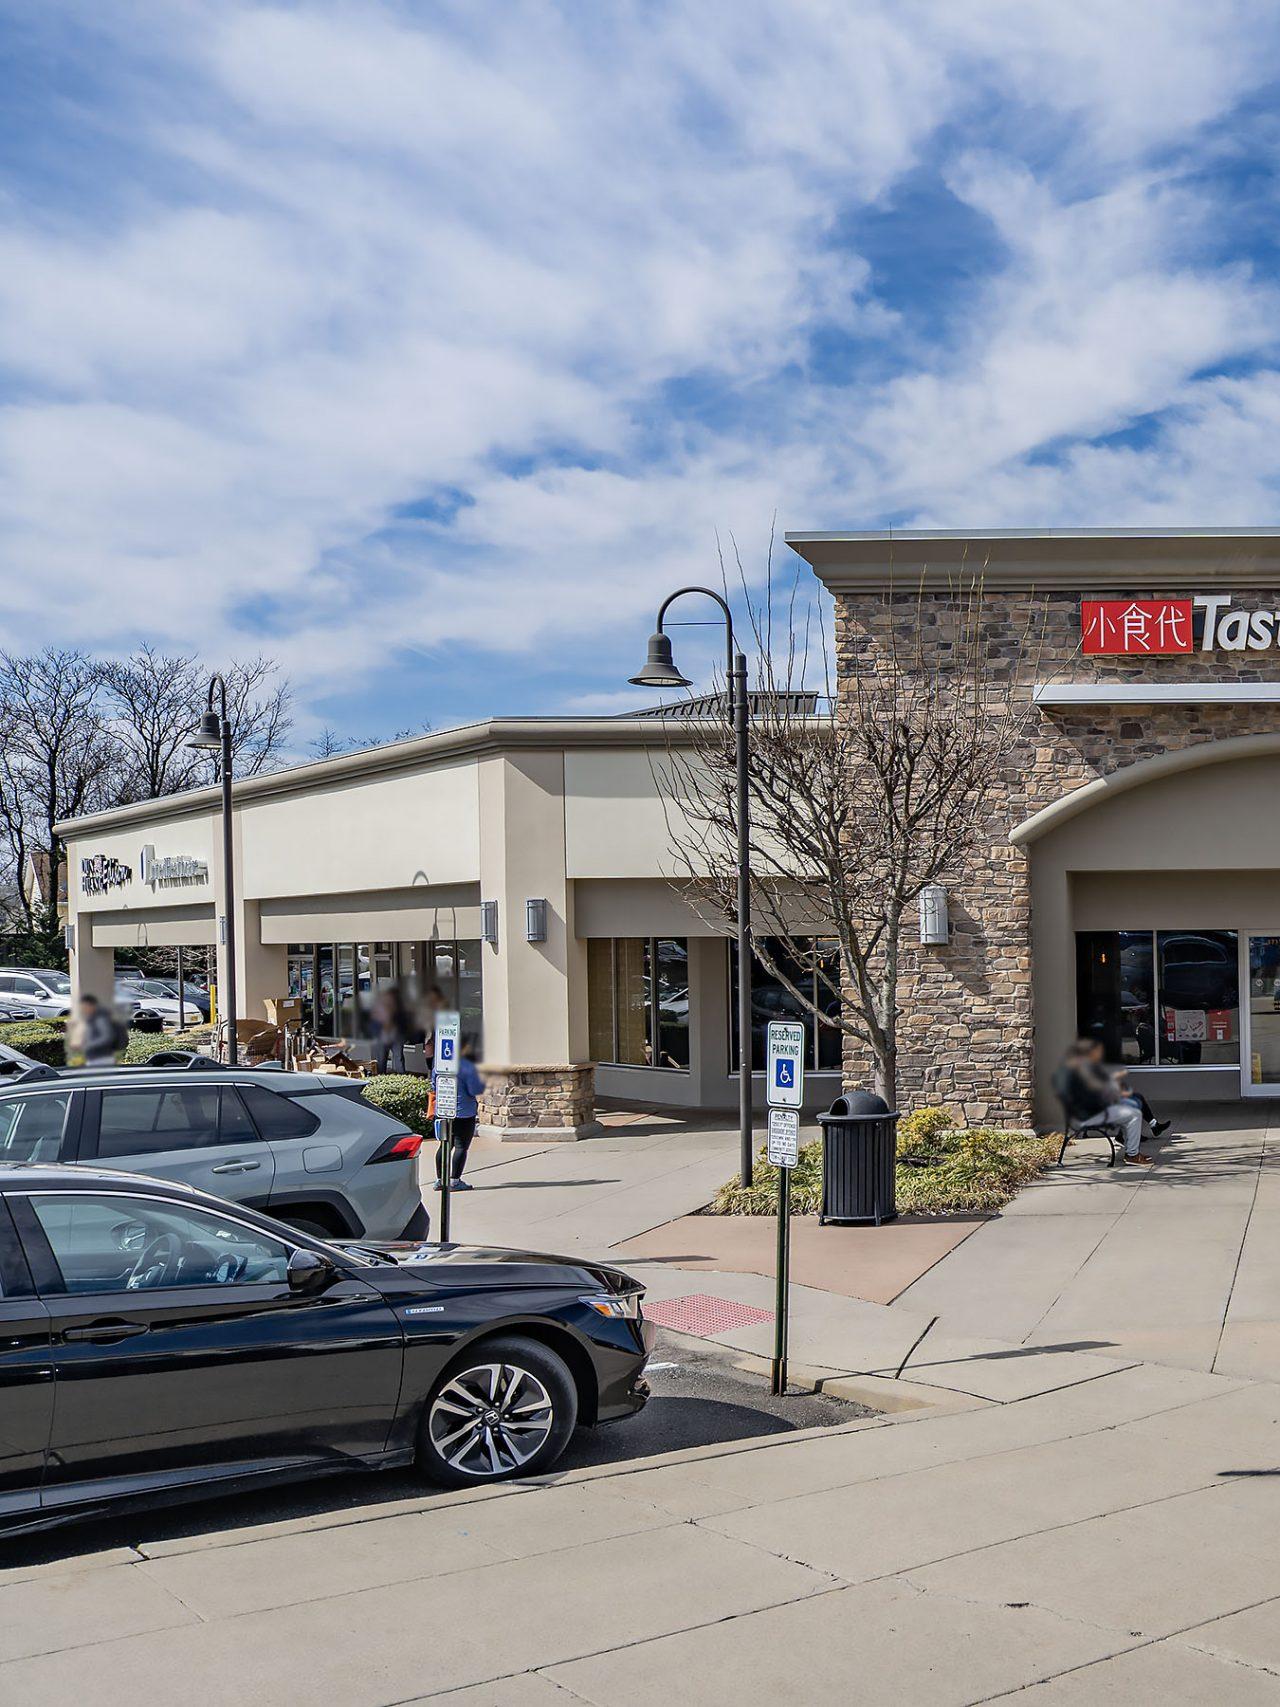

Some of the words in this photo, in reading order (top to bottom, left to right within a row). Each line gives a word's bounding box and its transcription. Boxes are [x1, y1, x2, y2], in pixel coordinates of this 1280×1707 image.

[1086, 602, 1188, 652] 小食代
[771, 1030, 800, 1041] RESERVED
[772, 1044, 799, 1056] PARKING
